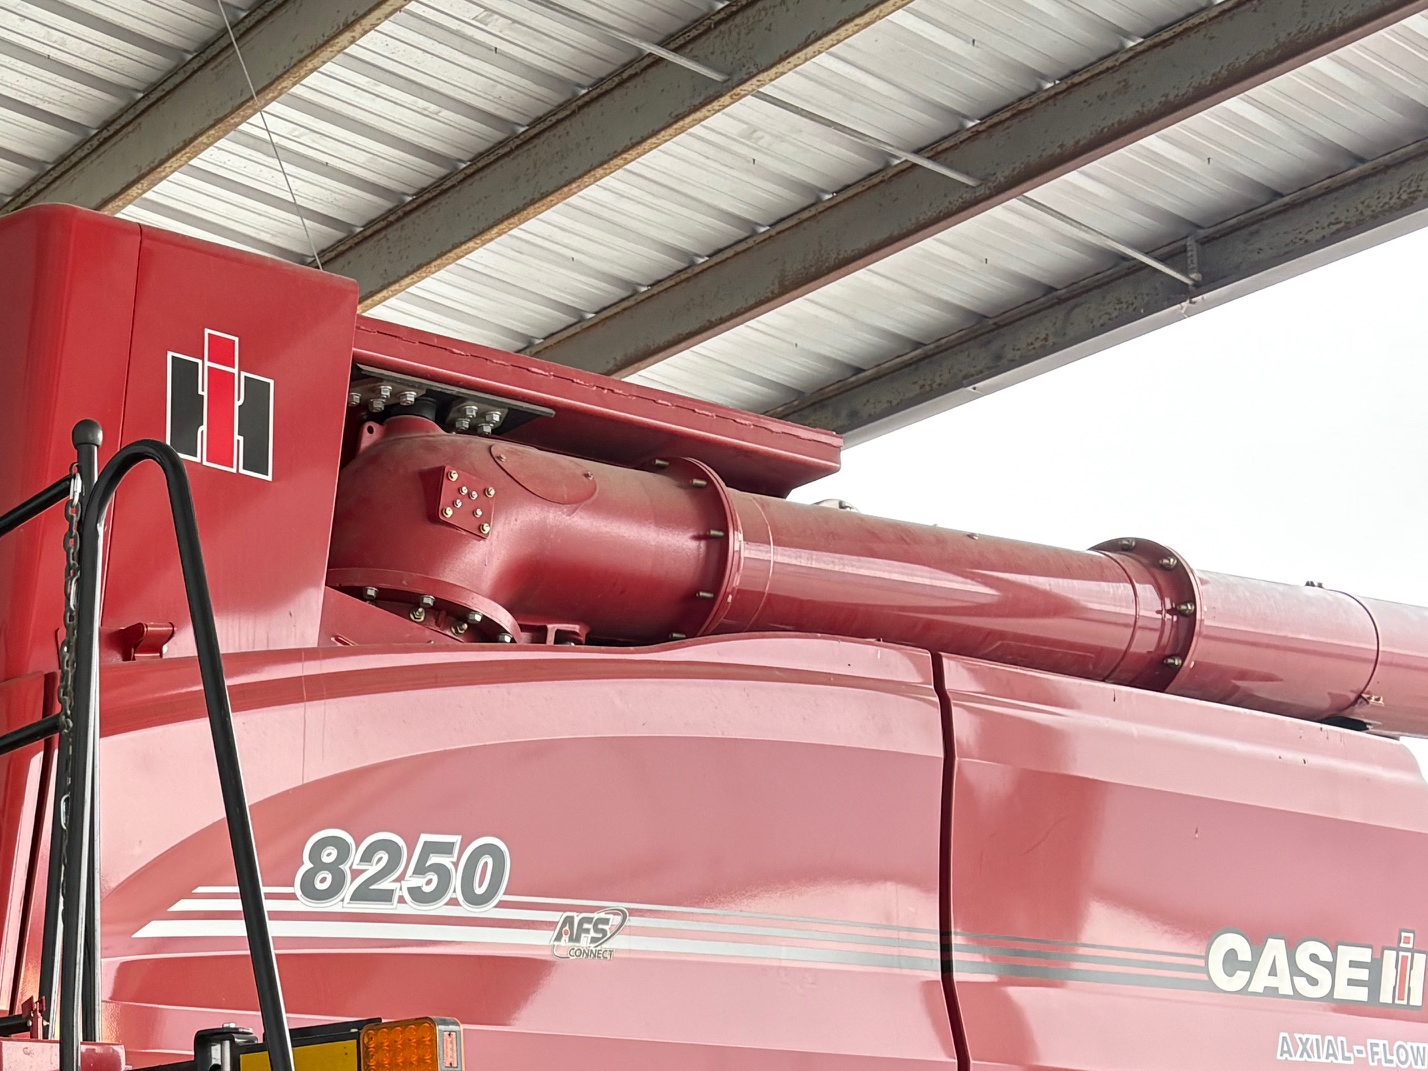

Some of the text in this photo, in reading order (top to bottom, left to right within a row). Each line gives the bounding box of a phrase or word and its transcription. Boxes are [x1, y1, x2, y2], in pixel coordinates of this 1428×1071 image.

[294, 828, 511, 913] 8250
[552, 914, 612, 945] AFS
[569, 947, 615, 960] CONNECT
[1208, 932, 1372, 1002] CASE
